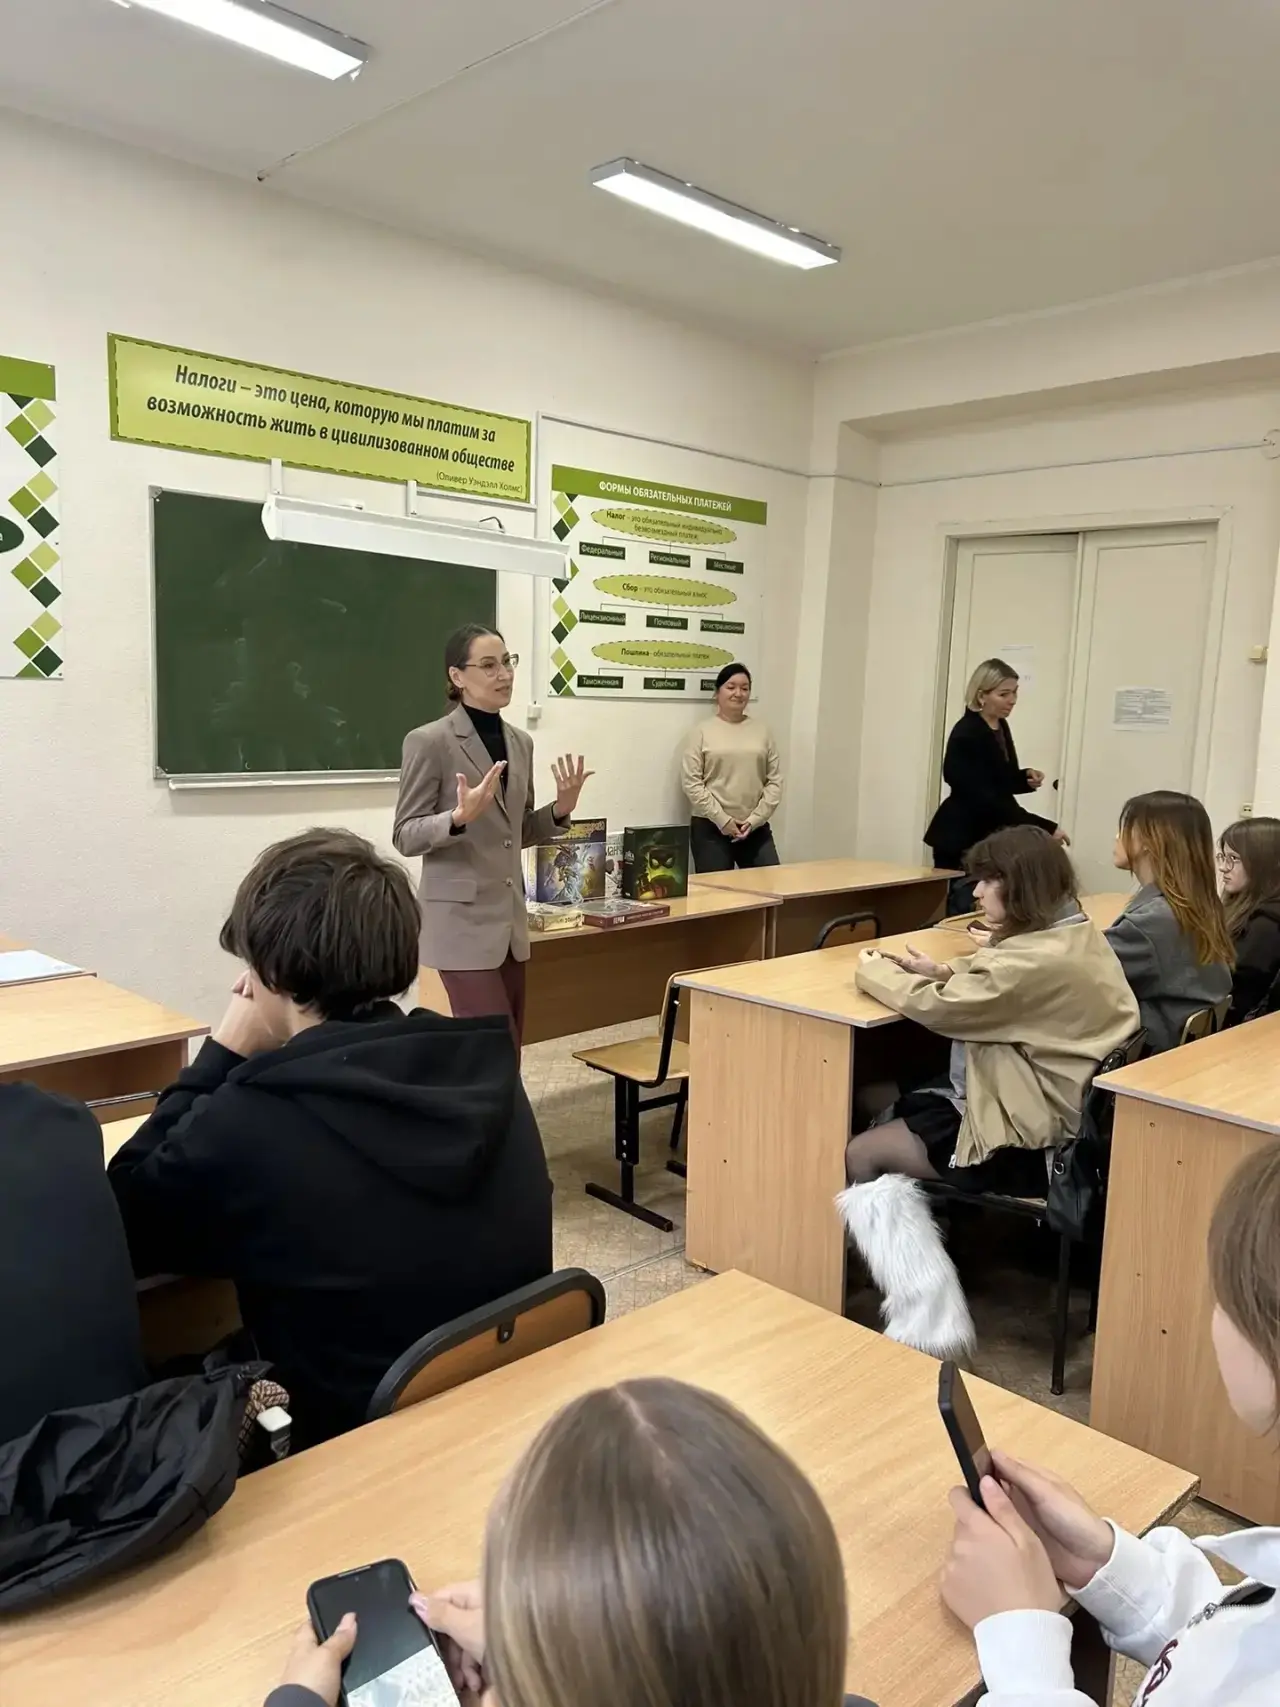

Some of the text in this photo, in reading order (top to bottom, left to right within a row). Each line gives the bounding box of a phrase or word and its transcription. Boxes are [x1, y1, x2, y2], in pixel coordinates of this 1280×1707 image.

[175, 364, 237, 394] Налоги
[254, 385, 287, 403] это
[290, 389, 330, 412] цена,
[334, 400, 399, 427] которую
[402, 413, 424, 430] мы
[426, 419, 480, 440] платим
[482, 428, 496, 443] за
[147, 396, 515, 473] возможность жить в цивилизованном обществе
[437, 471, 467, 485] (Оливер
[499, 481, 523, 493] Холмс)
[599, 481, 732, 512] ФОРМЫ ОБЯЗАТЕЛЬНЫХ ПЛАТЕЖЕЙ
[606, 511, 625, 520] Налог
[622, 583, 639, 593] Сбор
